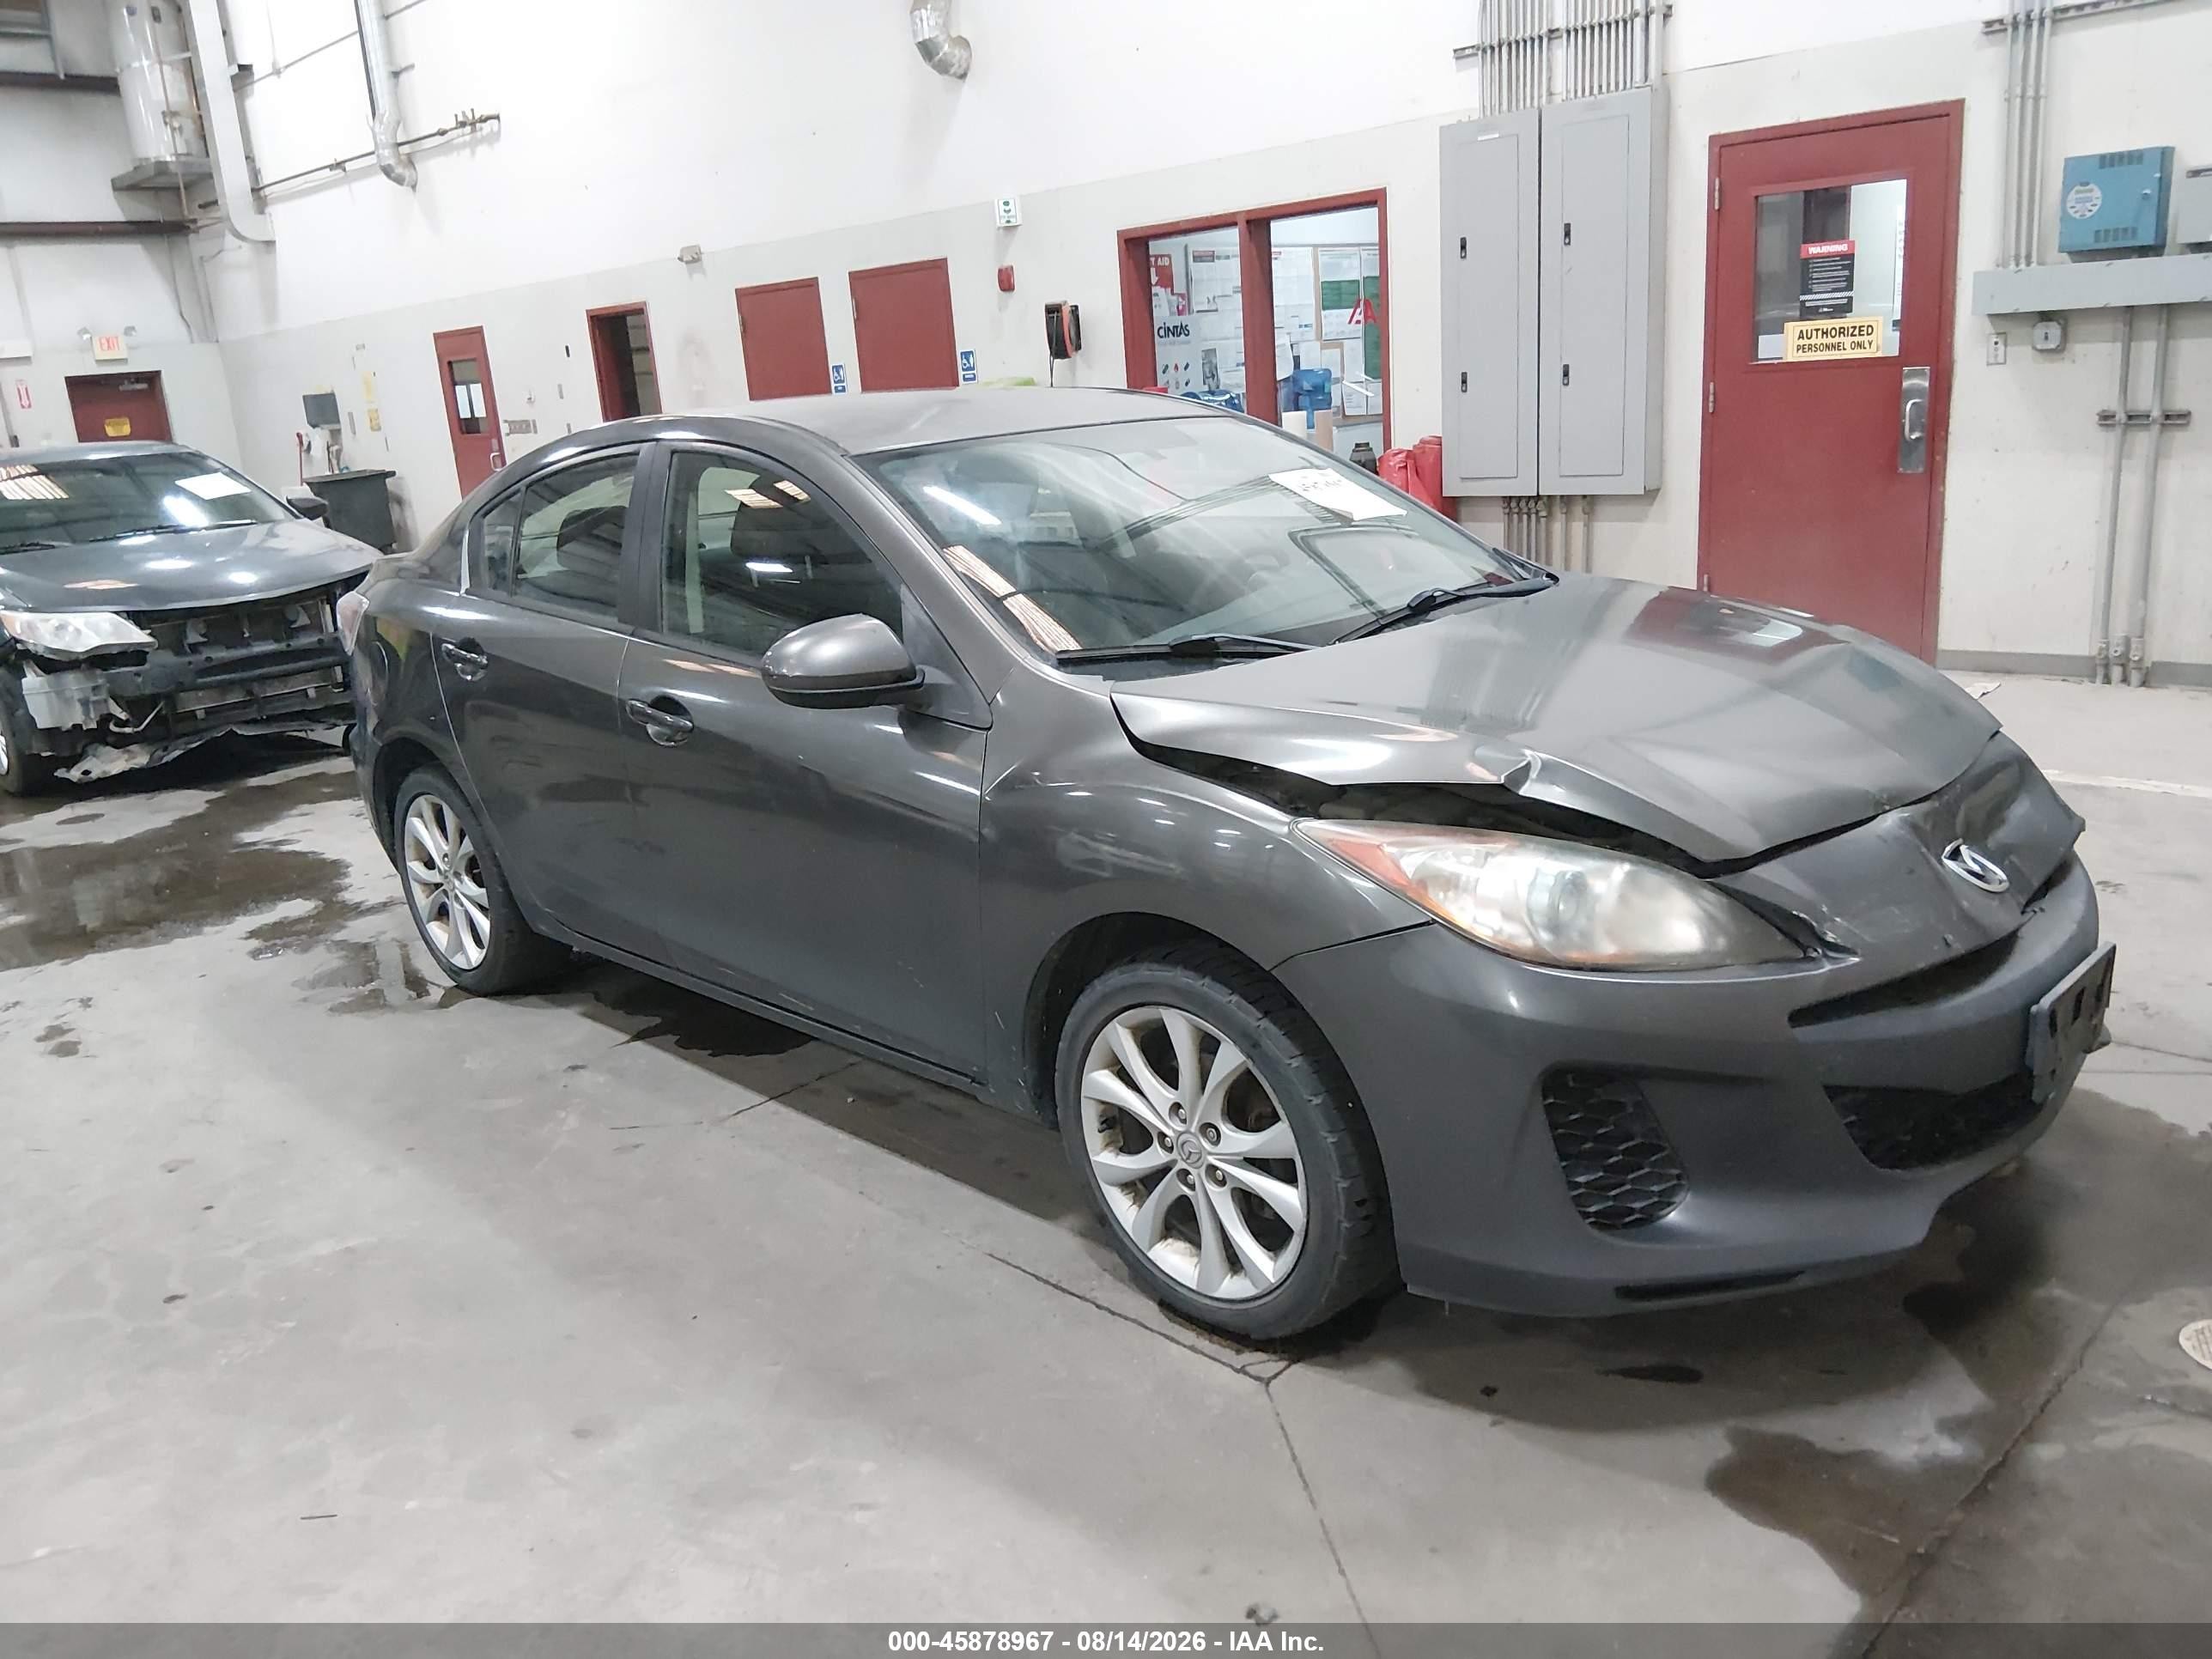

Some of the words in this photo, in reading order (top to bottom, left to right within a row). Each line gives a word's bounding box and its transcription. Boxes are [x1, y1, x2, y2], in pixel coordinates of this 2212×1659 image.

[1808, 243, 1848, 255] WARNING
[1157, 257, 1170, 266] AID
[1797, 325, 1874, 341] AUTHORIZED
[99, 336, 119, 351] EXIT
[1796, 341, 1847, 354] PERSONNEL
[1850, 339, 1874, 350] ONLY
